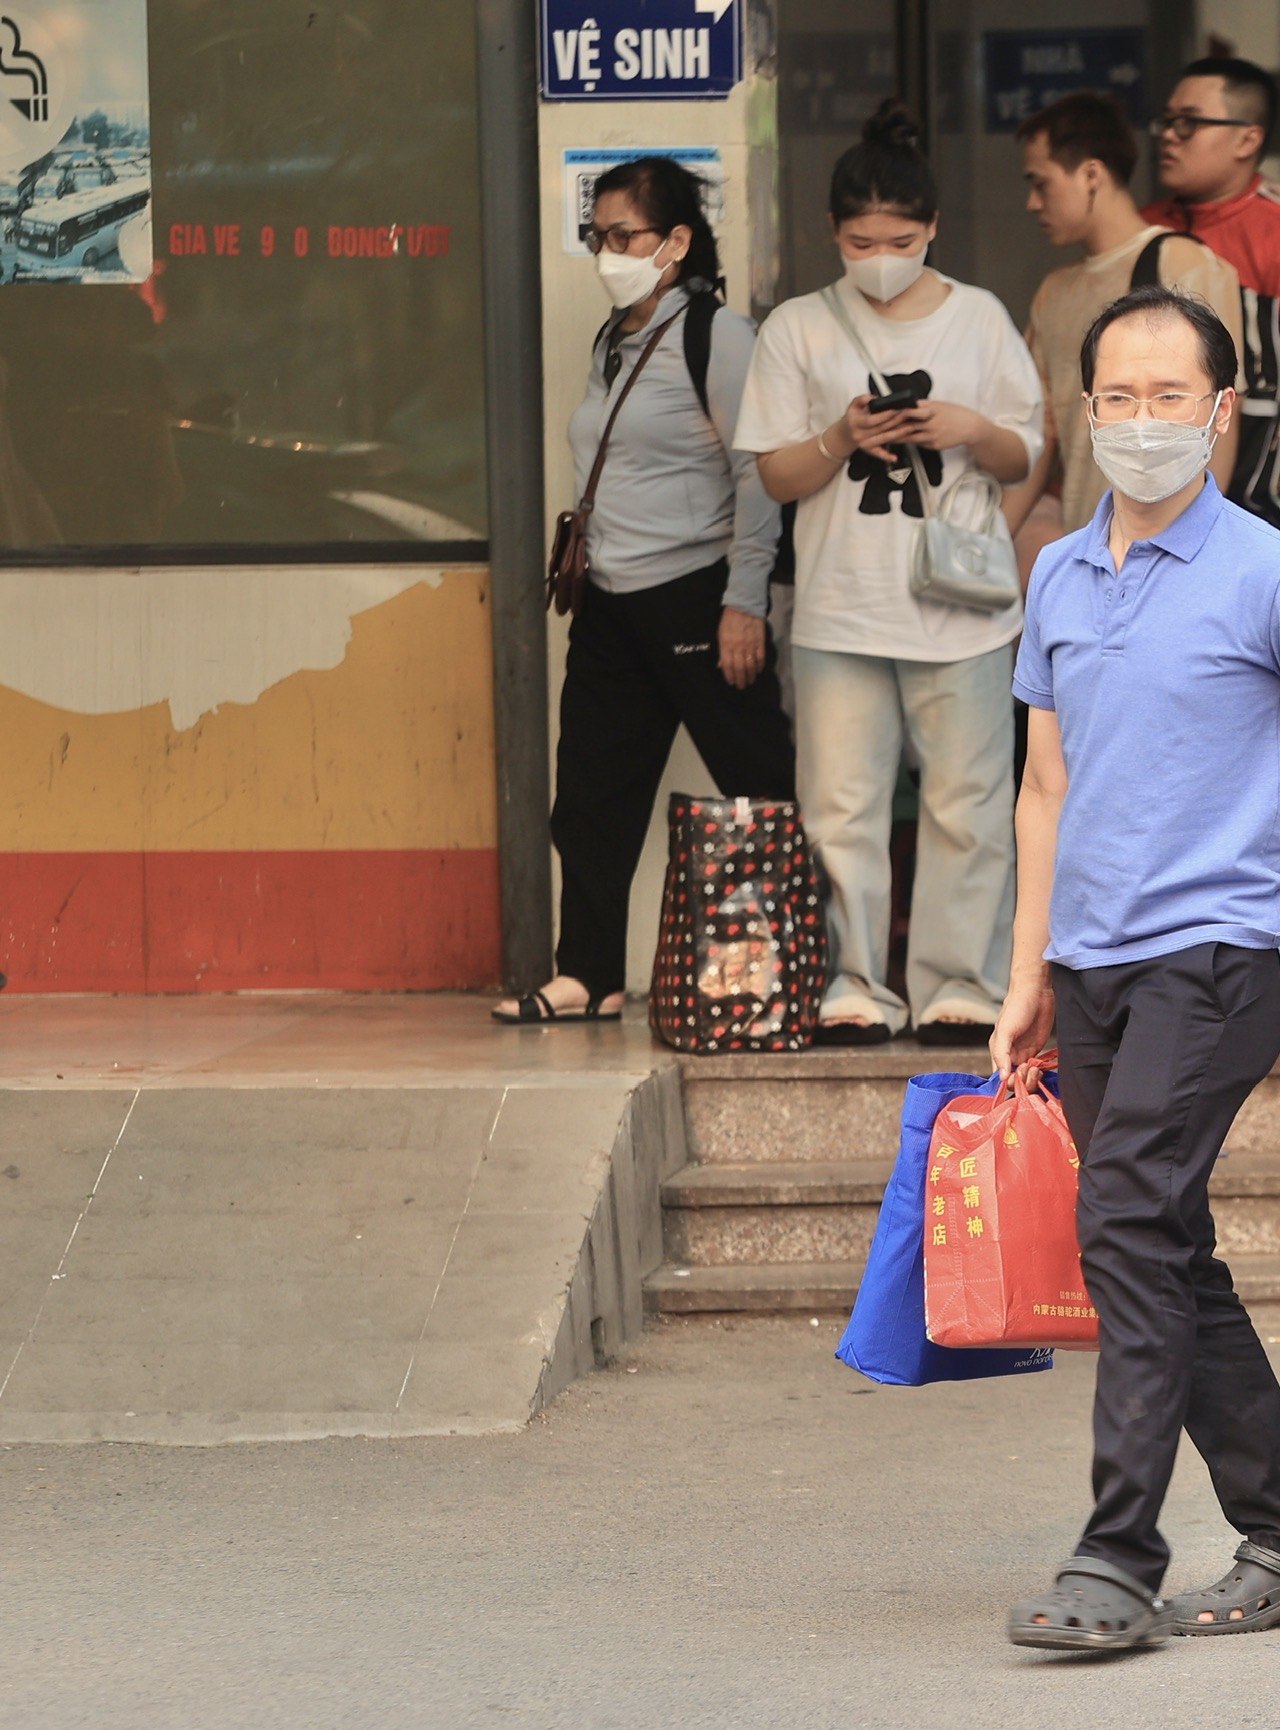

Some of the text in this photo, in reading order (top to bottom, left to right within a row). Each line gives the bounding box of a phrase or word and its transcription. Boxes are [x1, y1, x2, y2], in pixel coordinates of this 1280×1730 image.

[552, 18, 710, 92] VỆ SINH
[213, 224, 240, 255] VE
[1033, 1303, 1099, 1319] 内蒙古骆驼酒业集
